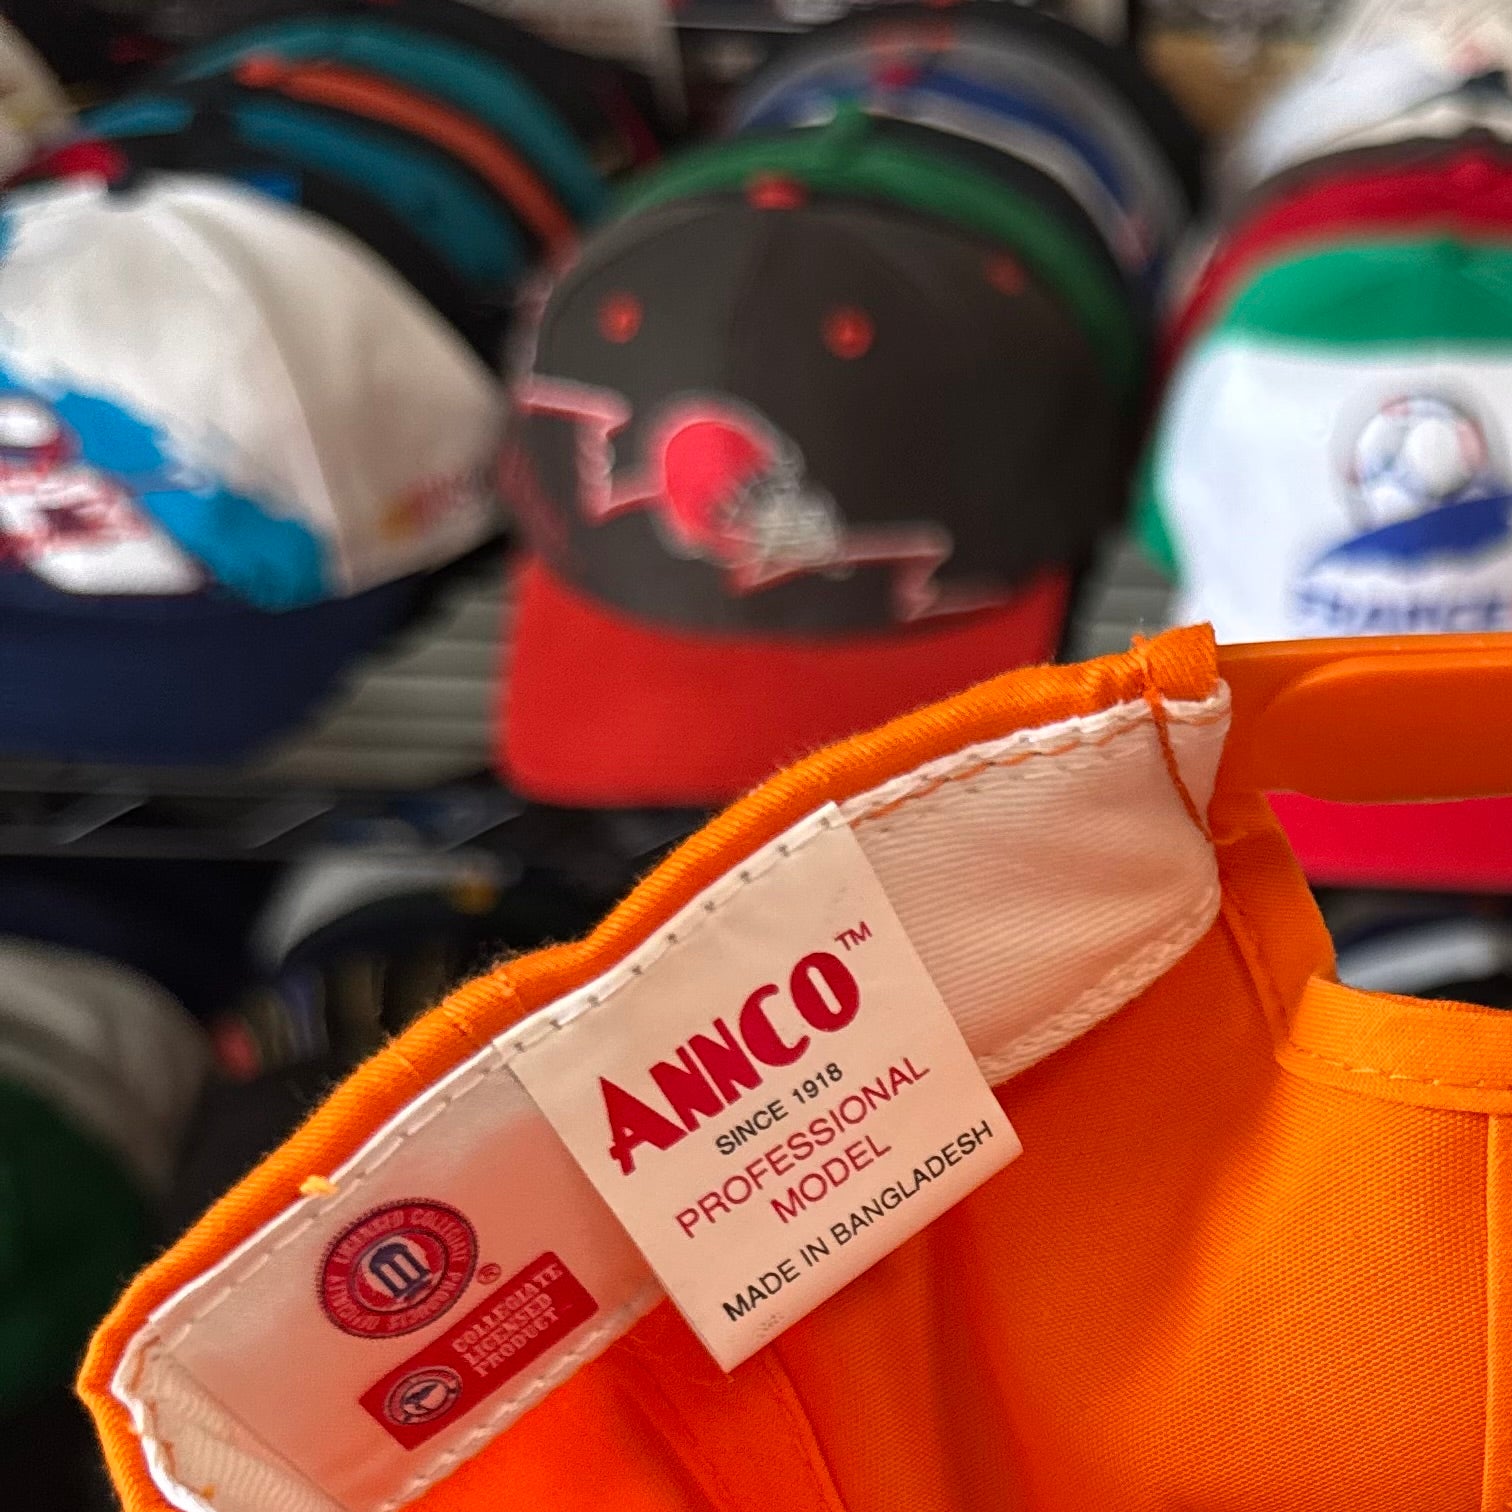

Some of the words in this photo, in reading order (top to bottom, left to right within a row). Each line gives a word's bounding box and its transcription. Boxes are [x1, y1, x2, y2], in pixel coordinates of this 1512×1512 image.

[597, 952, 860, 1175] ANNCO
[715, 1100, 789, 1155] SINCE
[792, 1062, 843, 1104] 1918
[674, 1057, 930, 1238] PROFESSIONAL
[770, 1135, 892, 1224] MODEL
[721, 1259, 801, 1322] MADE
[799, 1236, 831, 1267] IN
[830, 1120, 995, 1246] BANGLADESH
[452, 1263, 563, 1352] COLLEGIATE
[463, 1293, 552, 1365] LICENSED
[473, 1306, 559, 1377] PRODUCT
